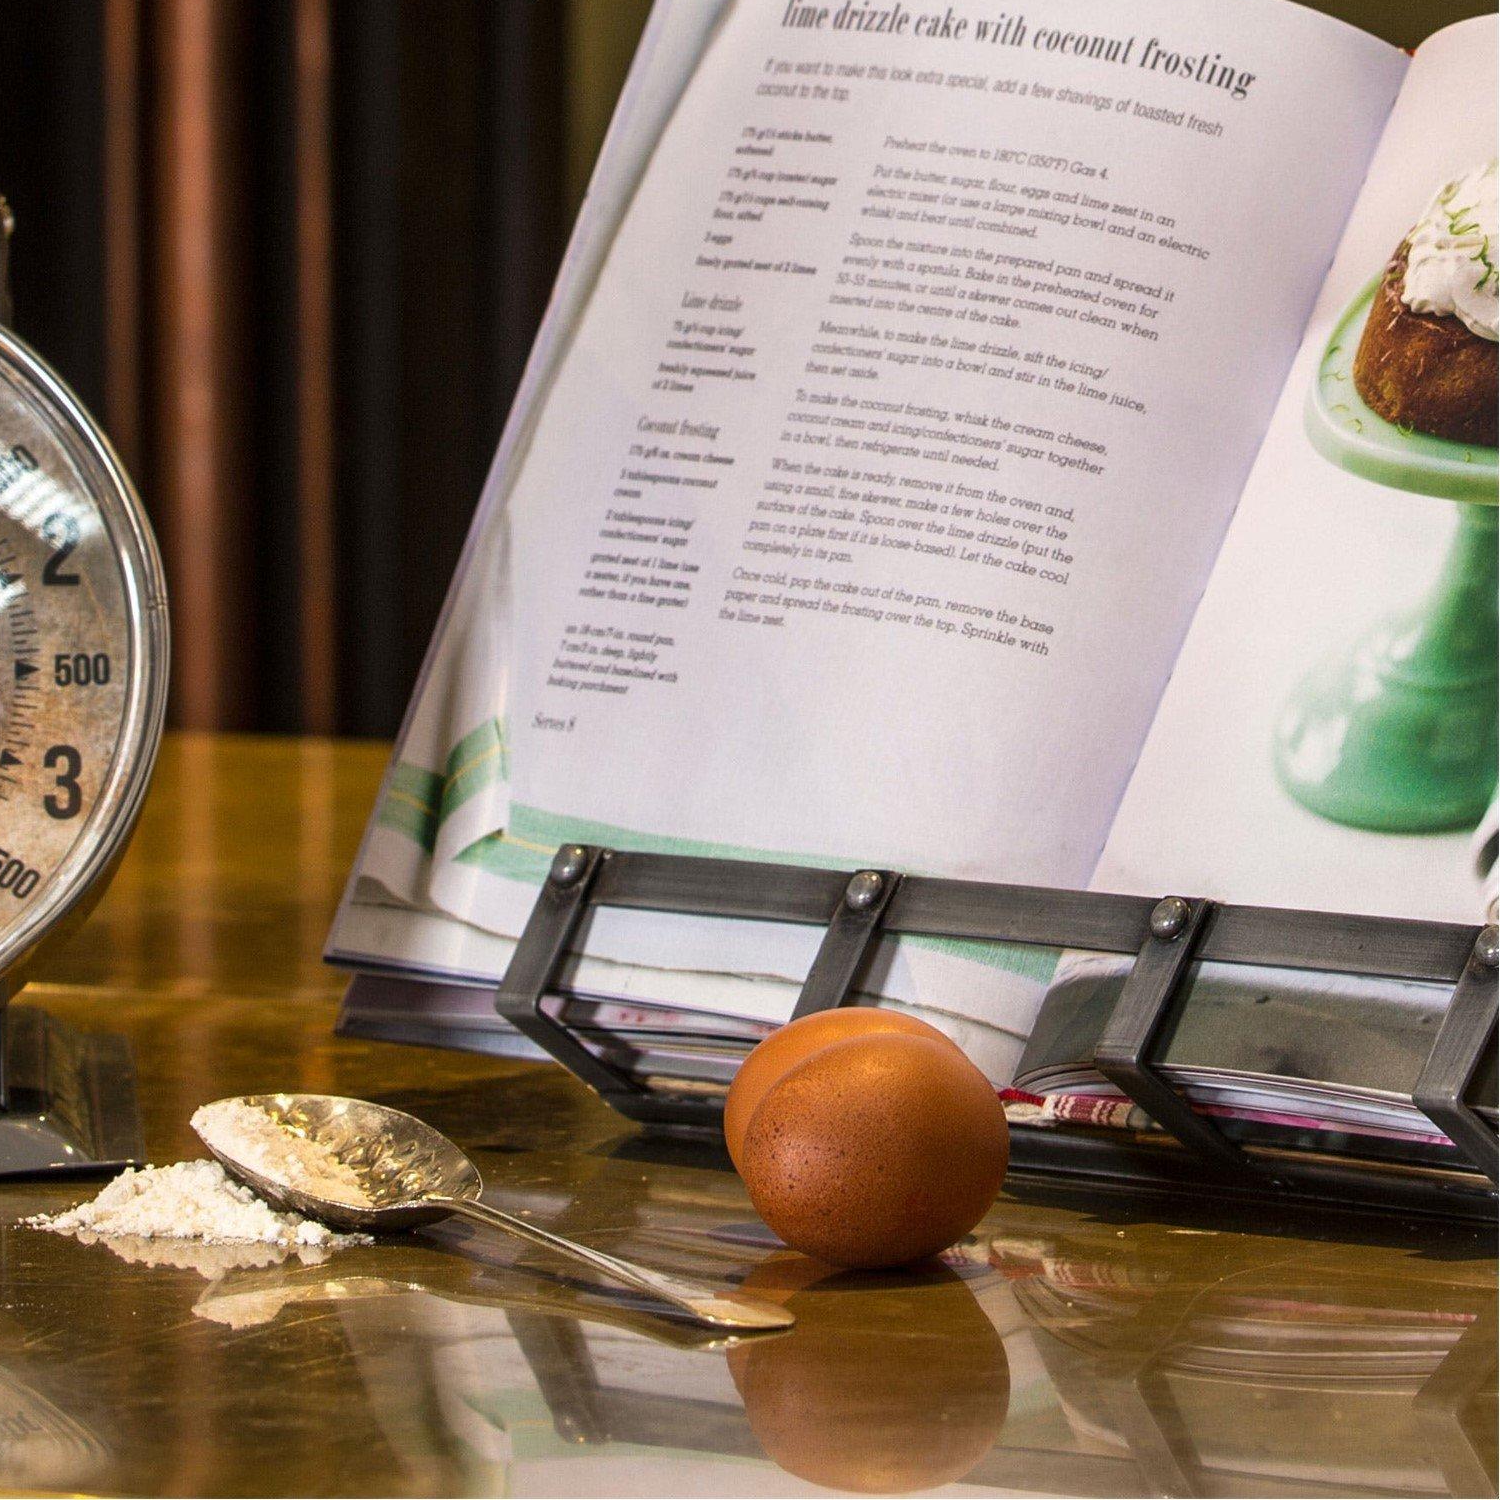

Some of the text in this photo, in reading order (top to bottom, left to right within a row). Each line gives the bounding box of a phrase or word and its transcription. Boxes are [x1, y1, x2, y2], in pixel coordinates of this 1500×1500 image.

[832, 0, 909, 33] drizzle
[913, 7, 968, 39] cake
[975, 12, 1027, 46] with
[1032, 29, 1134, 64] coconut
[1139, 38, 1255, 98] frosting
[991, 78, 1018, 94] add
[1017, 82, 1029, 96] a
[1030, 81, 1055, 99] few
[1055, 87, 1113, 112] shavings
[1114, 97, 1132, 113] of
[1132, 101, 1185, 126] toasted
[1186, 113, 1224, 137] fresh
[1069, 160, 1097, 178] Gas
[1051, 191, 1176, 229] and lime zest in an
[1026, 207, 1210, 260] mixing bowl and an electric
[993, 253, 1175, 303] prepared pan and spread it
[1010, 273, 1159, 319] the preheated oven for
[1011, 297, 1159, 341] comes out clean when
[986, 366, 1015, 380] and
[1013, 370, 1036, 384] stir
[1036, 373, 1051, 388] in
[1053, 376, 1076, 393] the
[1076, 381, 1108, 401] lime
[1022, 350, 1044, 364] sift
[1044, 353, 1067, 369] the
[1067, 360, 1109, 380] icing/
[953, 411, 989, 427] whisk
[990, 415, 1012, 431] the
[1012, 423, 1055, 441] cream
[1005, 443, 1104, 475] sugar together
[943, 481, 955, 494] it
[954, 482, 984, 500] from
[985, 488, 1008, 504] the
[1008, 496, 1043, 513] oven
[924, 519, 1074, 564] the lime drizzle (put the
[938, 503, 1068, 541] a few holes over the
[42, 511, 81, 586] 2
[958, 545, 981, 562] Let
[981, 551, 1003, 567] the
[1003, 559, 1037, 576] cake
[1037, 568, 1070, 585] cool
[883, 610, 912, 624] over
[912, 612, 934, 628] the
[960, 621, 1017, 646] Sprinkle
[1019, 638, 1049, 656] with
[893, 588, 914, 603] the
[944, 600, 994, 619] remove
[995, 608, 1018, 625] the
[1018, 614, 1054, 635] base
[53, 653, 111, 686] 500
[43, 744, 83, 820] 3
